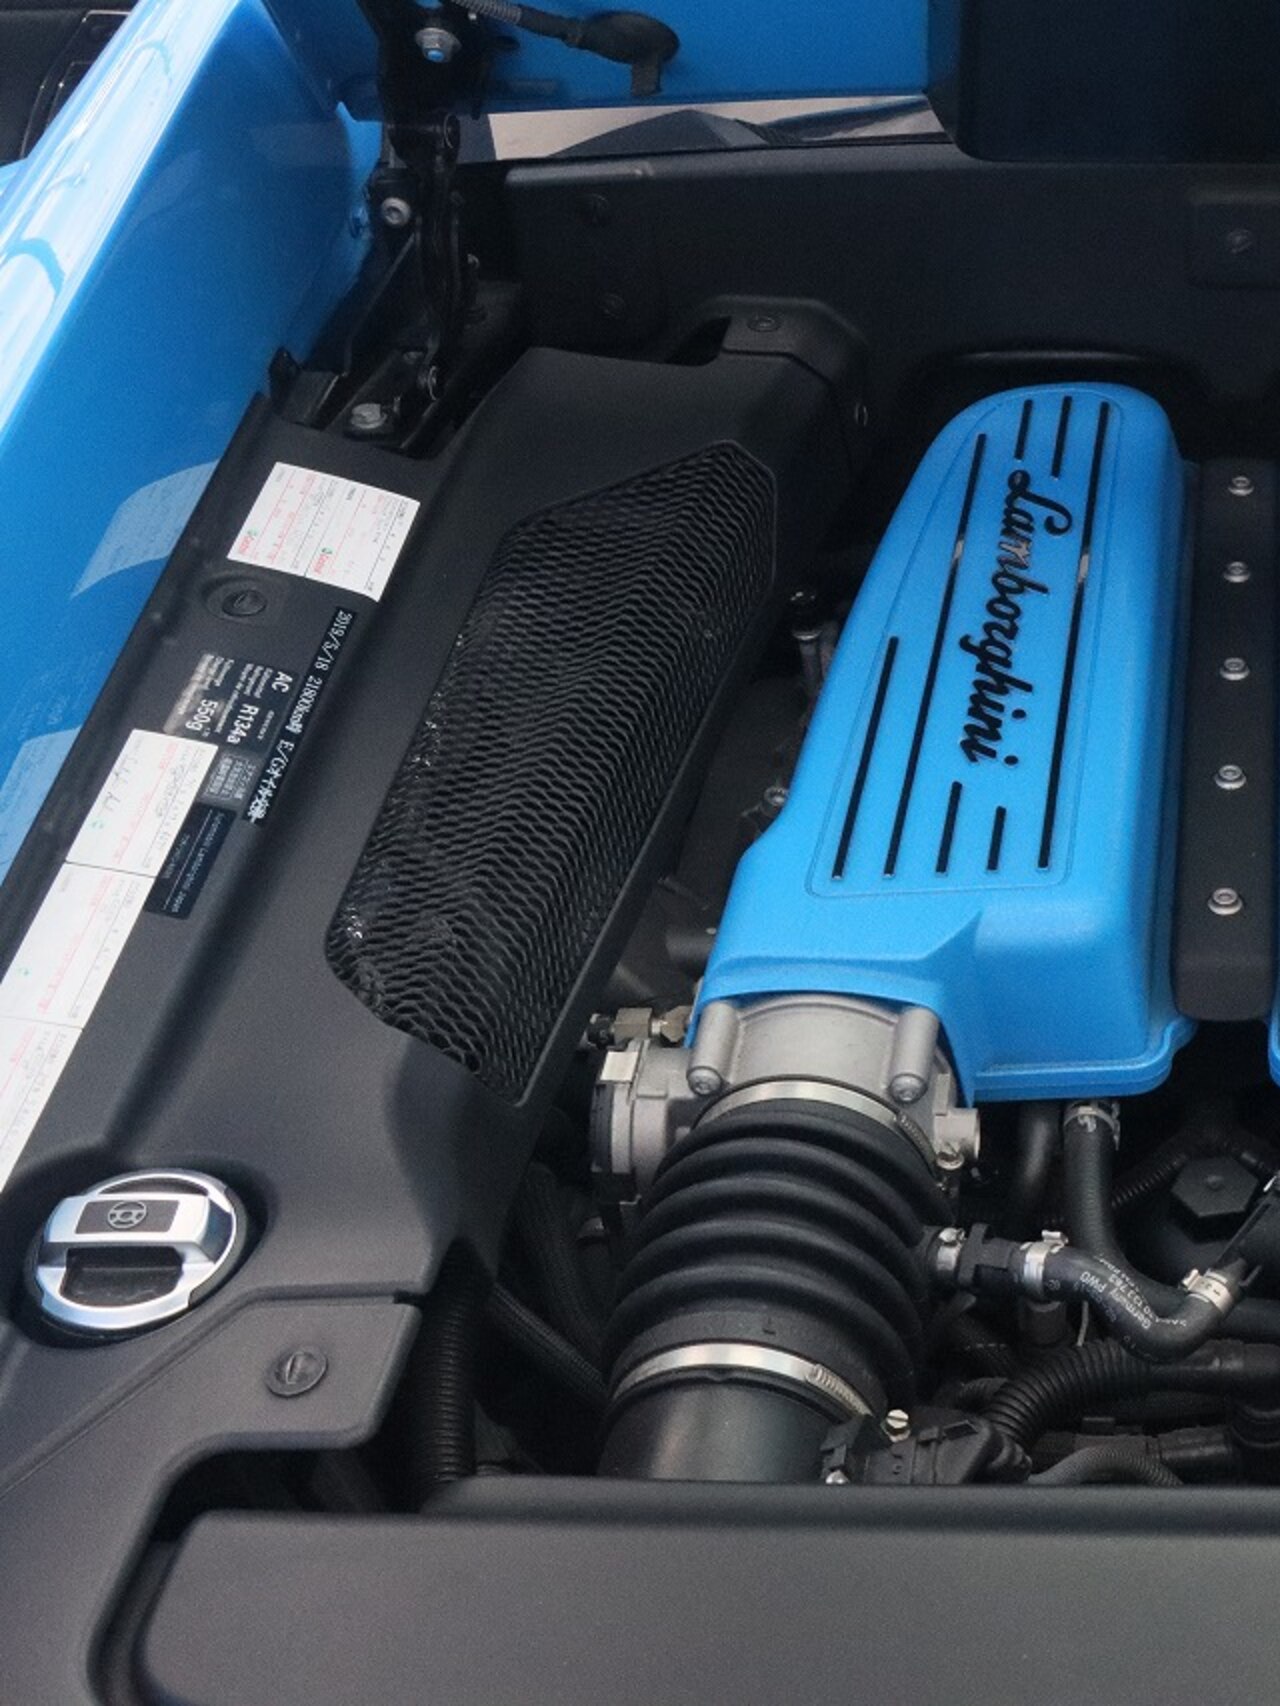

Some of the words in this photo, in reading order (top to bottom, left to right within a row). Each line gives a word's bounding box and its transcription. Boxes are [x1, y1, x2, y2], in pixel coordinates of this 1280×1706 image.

[959, 469, 1073, 766] Lamborghini
[315, 610, 353, 671] 2019/5/18
[271, 671, 293, 693] AC
[185, 699, 218, 731] 550g
[227, 703, 259, 744] R134a
